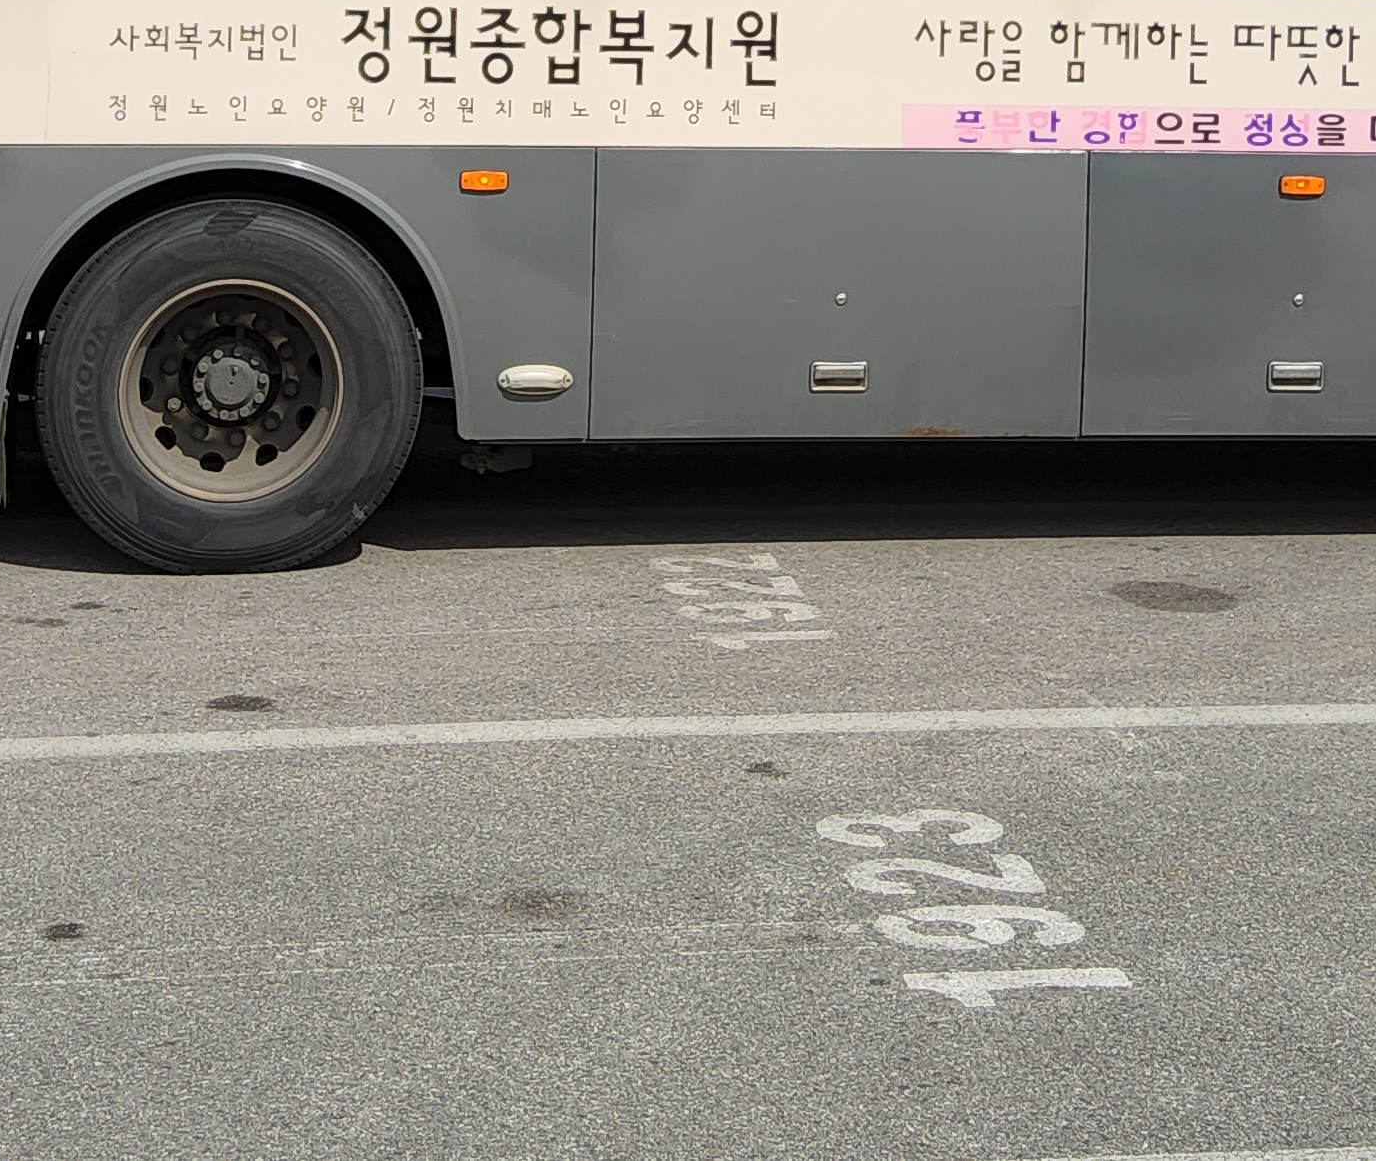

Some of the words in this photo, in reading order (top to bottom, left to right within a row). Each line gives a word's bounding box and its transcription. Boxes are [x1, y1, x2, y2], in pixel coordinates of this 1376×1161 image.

[109, 22, 298, 62] 사회복지법인
[340, 6, 779, 87] 정원종합복지원
[914, 19, 1023, 83] 사랑을
[1050, 20, 1209, 86] 함께하는
[1234, 24, 1361, 88] 따뜻한
[1244, 113, 1347, 147] 정성을
[815, 807, 1134, 1008] 1923
